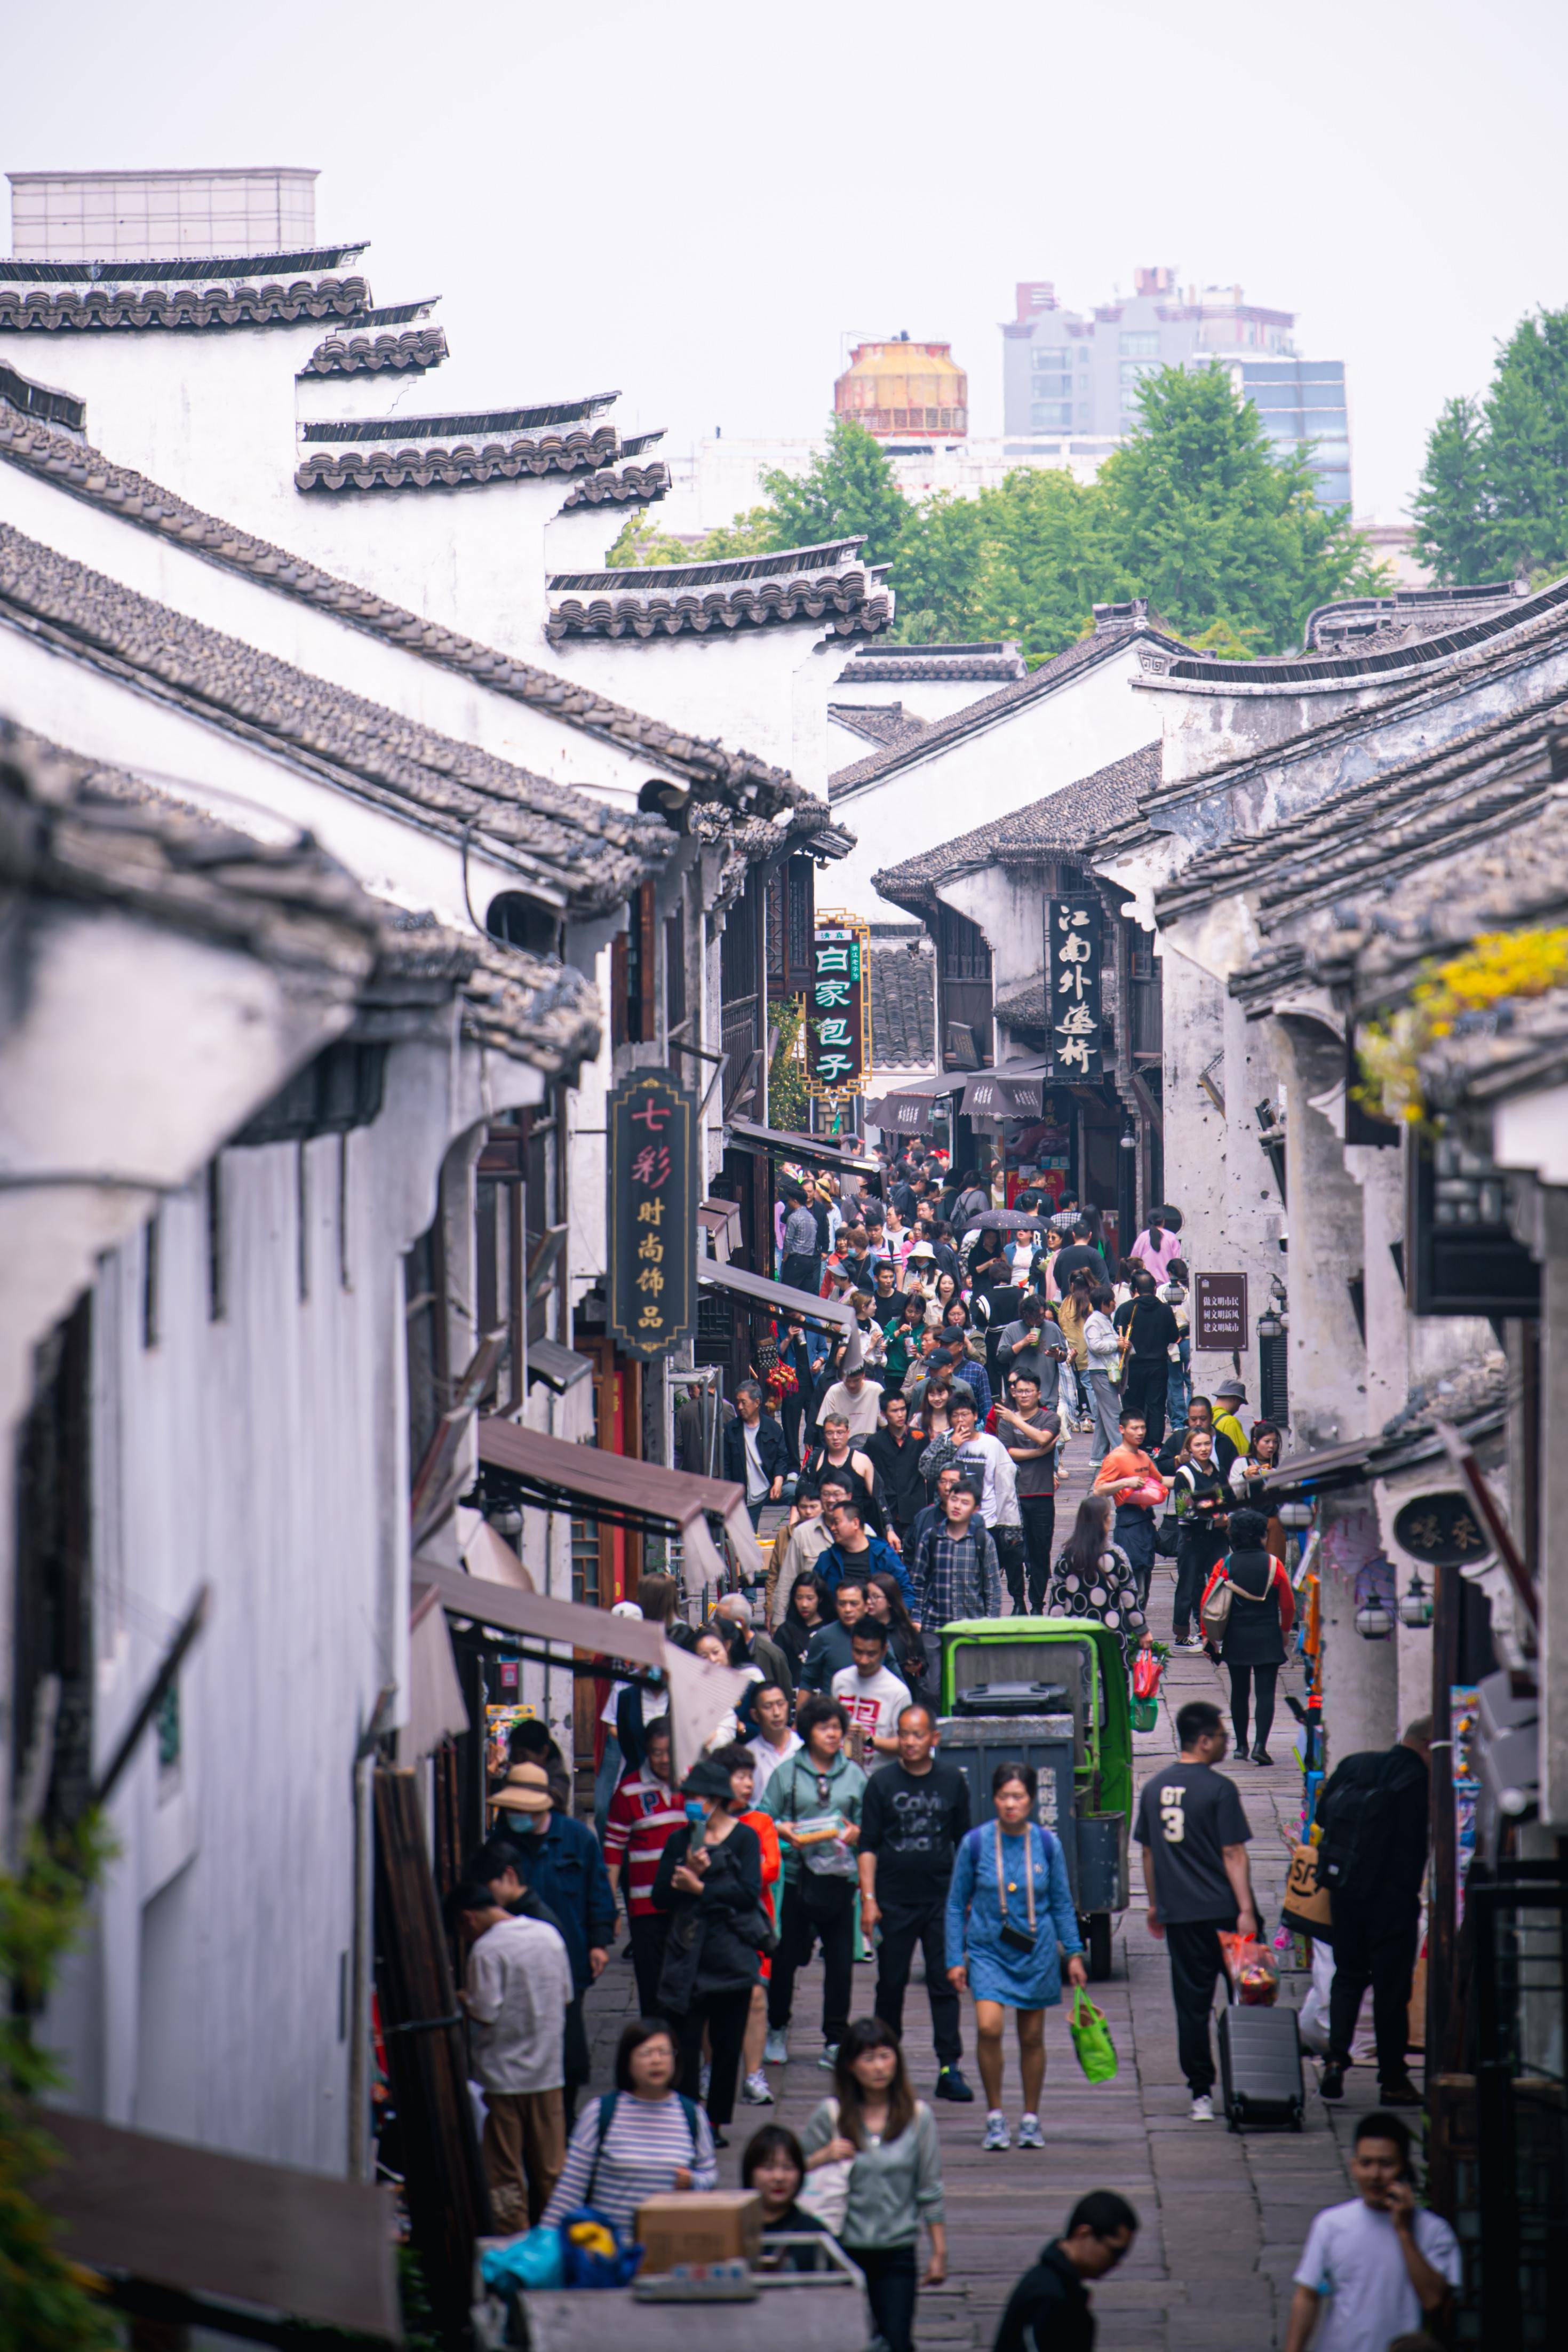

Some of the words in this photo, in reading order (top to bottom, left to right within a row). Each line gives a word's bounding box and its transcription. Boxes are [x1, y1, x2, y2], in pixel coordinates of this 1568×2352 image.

[851, 945, 859, 979] 浙江老字号
[1055, 905, 1097, 1073] 江南外婆桥
[815, 946, 853, 1080] 白家包子
[631, 1098, 672, 1329] 七彩时尚饰品
[1203, 1297, 1239, 1306] 做文明市民
[1204, 1309, 1239, 1320] 树文明新风
[1204, 1323, 1239, 1332] 建文明城市
[638, 1791, 660, 1815] P
[1160, 1786, 1187, 1806] GT
[1160, 1807, 1185, 1843] 3
